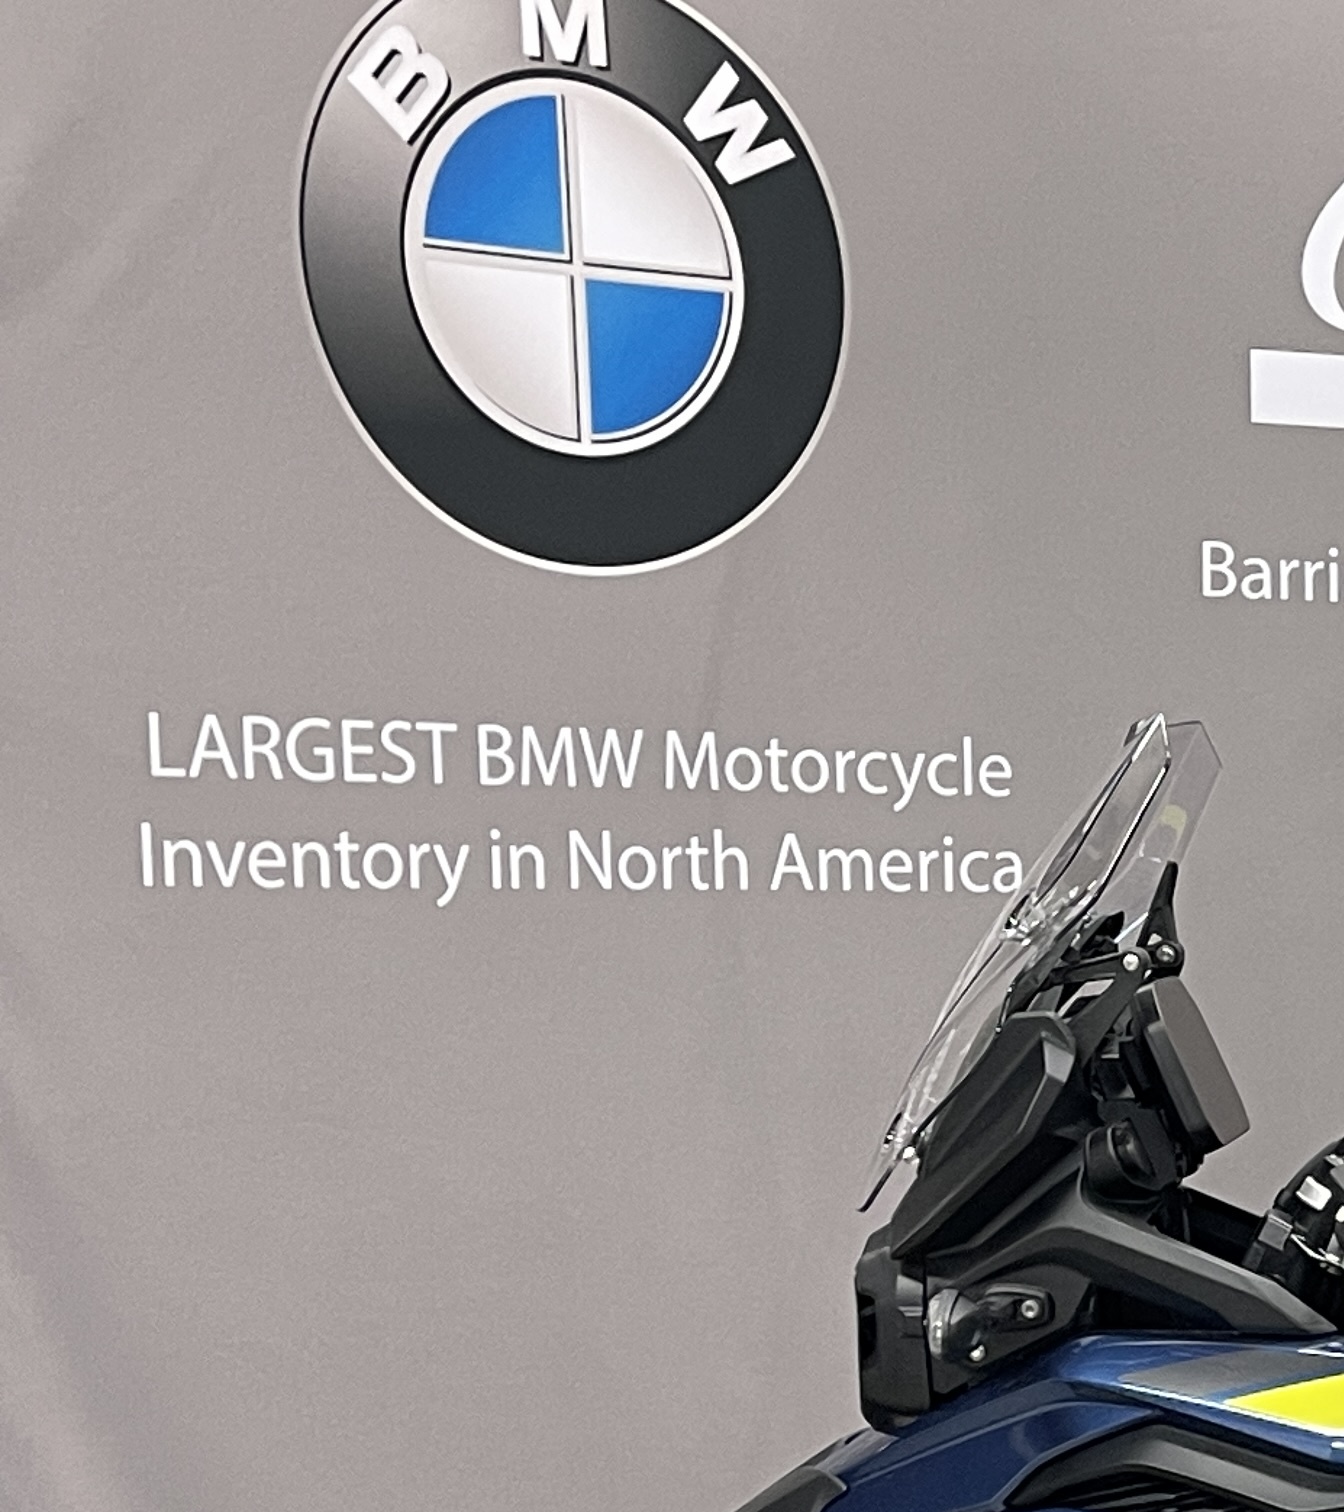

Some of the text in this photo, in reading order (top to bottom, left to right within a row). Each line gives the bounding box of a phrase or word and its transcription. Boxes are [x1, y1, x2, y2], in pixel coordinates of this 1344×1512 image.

[346, 0, 795, 185] BMW
[147, 711, 1014, 812] LARGEST BMW Motorcycle
[140, 821, 1023, 908] Inventory in North America
